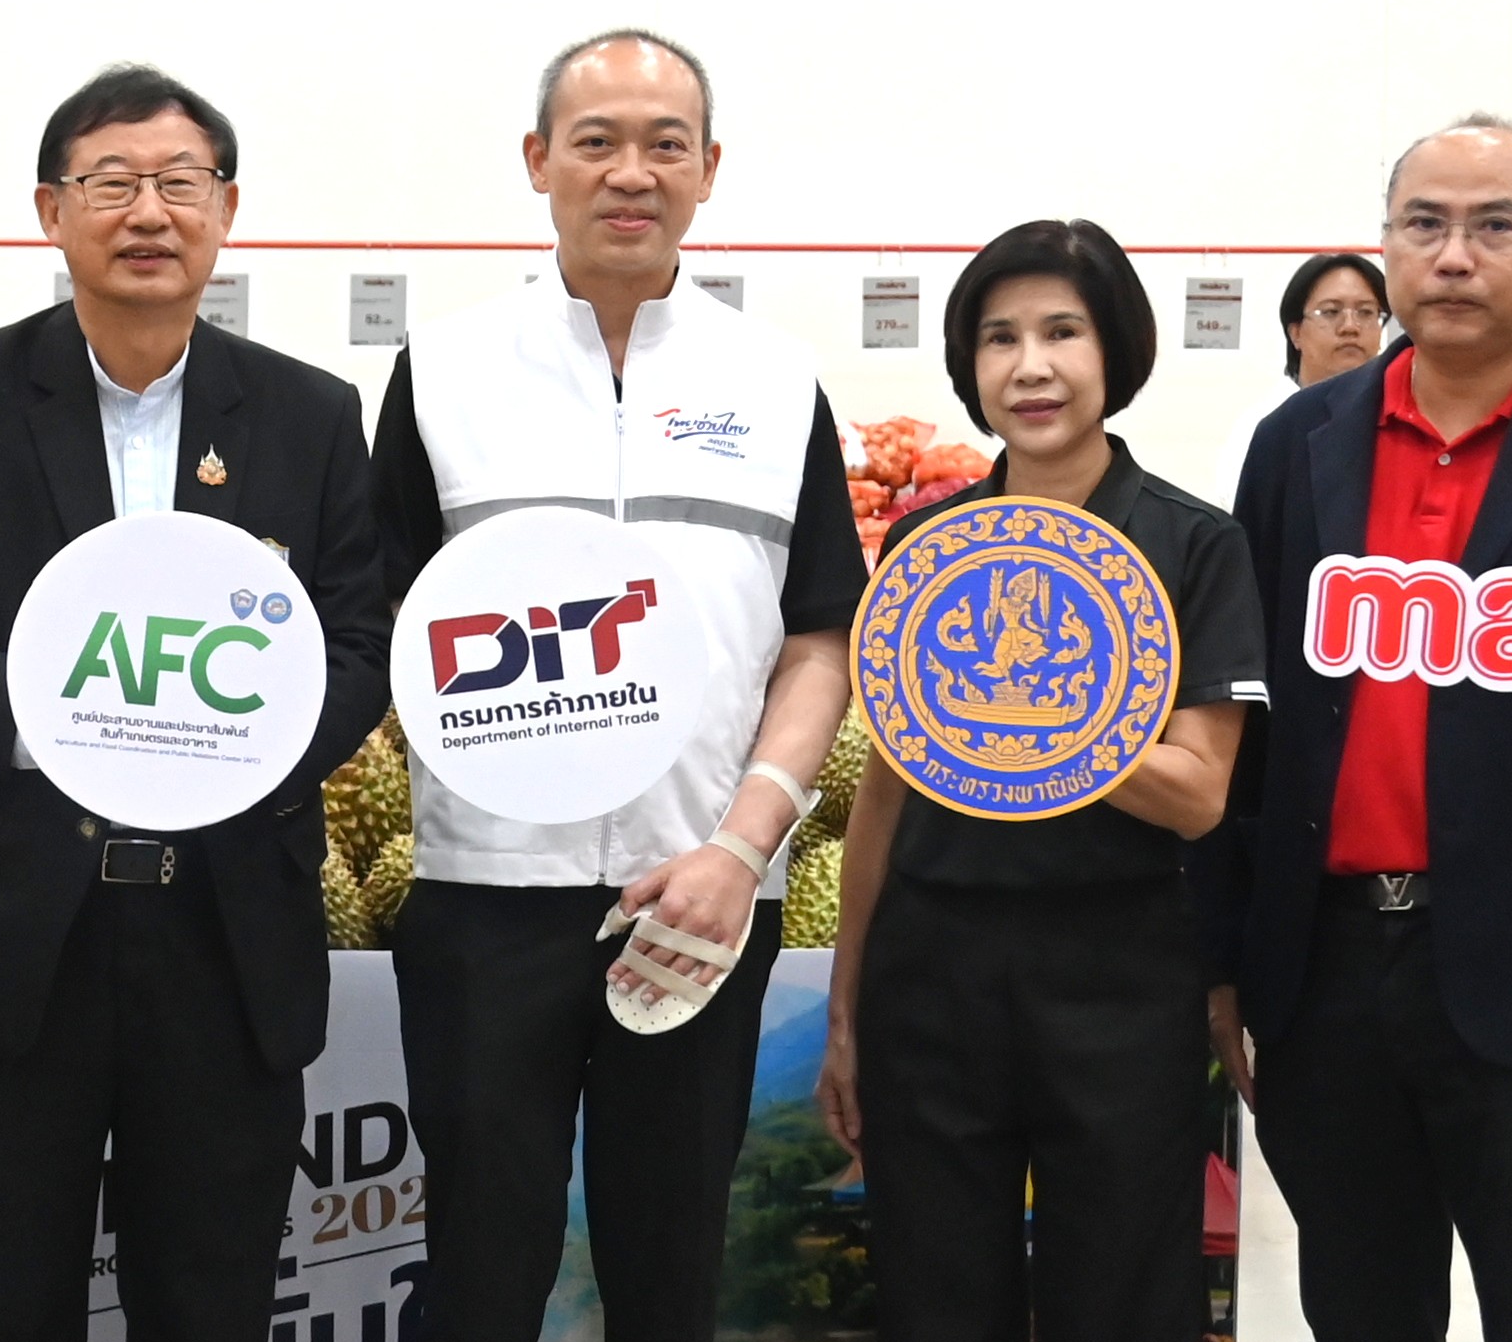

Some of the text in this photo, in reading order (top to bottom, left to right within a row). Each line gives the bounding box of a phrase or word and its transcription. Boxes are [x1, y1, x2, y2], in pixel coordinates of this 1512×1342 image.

[60, 611, 272, 715] AFC
[72, 711, 250, 738] ศูนย์ประสานงานและประชาสัมพันธ์
[439, 681, 658, 730] กรมการค้าภายใน
[100, 728, 217, 749] สินค้าเกษตรและอาหาร
[442, 710, 660, 750] Department of Internal Trade
[925, 757, 1095, 804] กระทรวงพาณิชย์
[310, 1175, 426, 1245] 202
